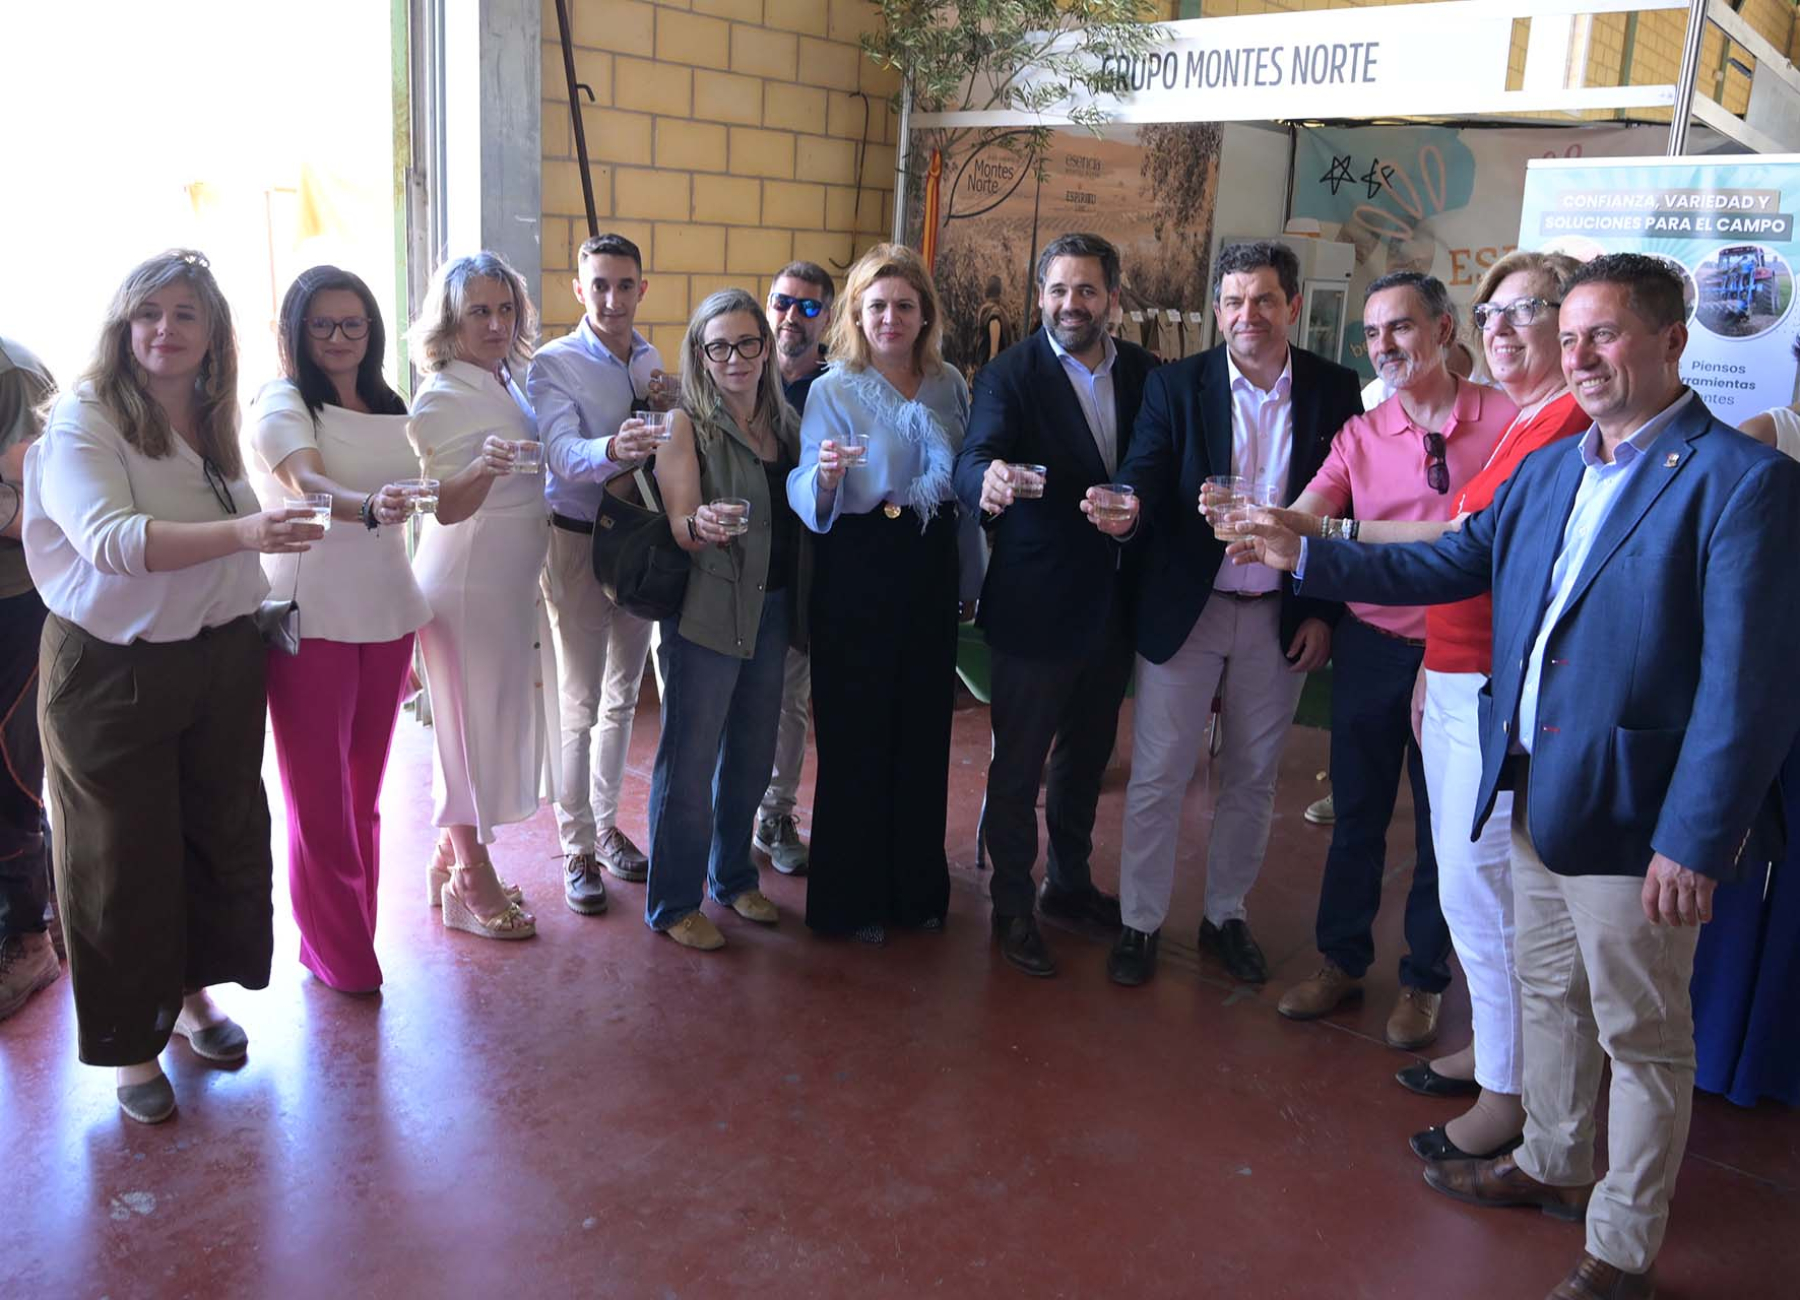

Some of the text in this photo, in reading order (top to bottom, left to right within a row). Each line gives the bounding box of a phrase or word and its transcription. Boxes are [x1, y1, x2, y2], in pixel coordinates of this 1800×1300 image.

[1184, 46, 1284, 88] MONTES
[1291, 42, 1380, 85] NORTE
[974, 158, 1015, 180] Montes
[967, 174, 999, 194] Norte
[1563, 194, 1771, 211] CONFIANZA, VARIEDAD Y
[1544, 216, 1786, 233] SOLUCIONES PARA EL CAMPO
[1691, 360, 1746, 374] Piensos
[1682, 377, 1756, 390] rramientas
[1701, 394, 1735, 405] ntes
